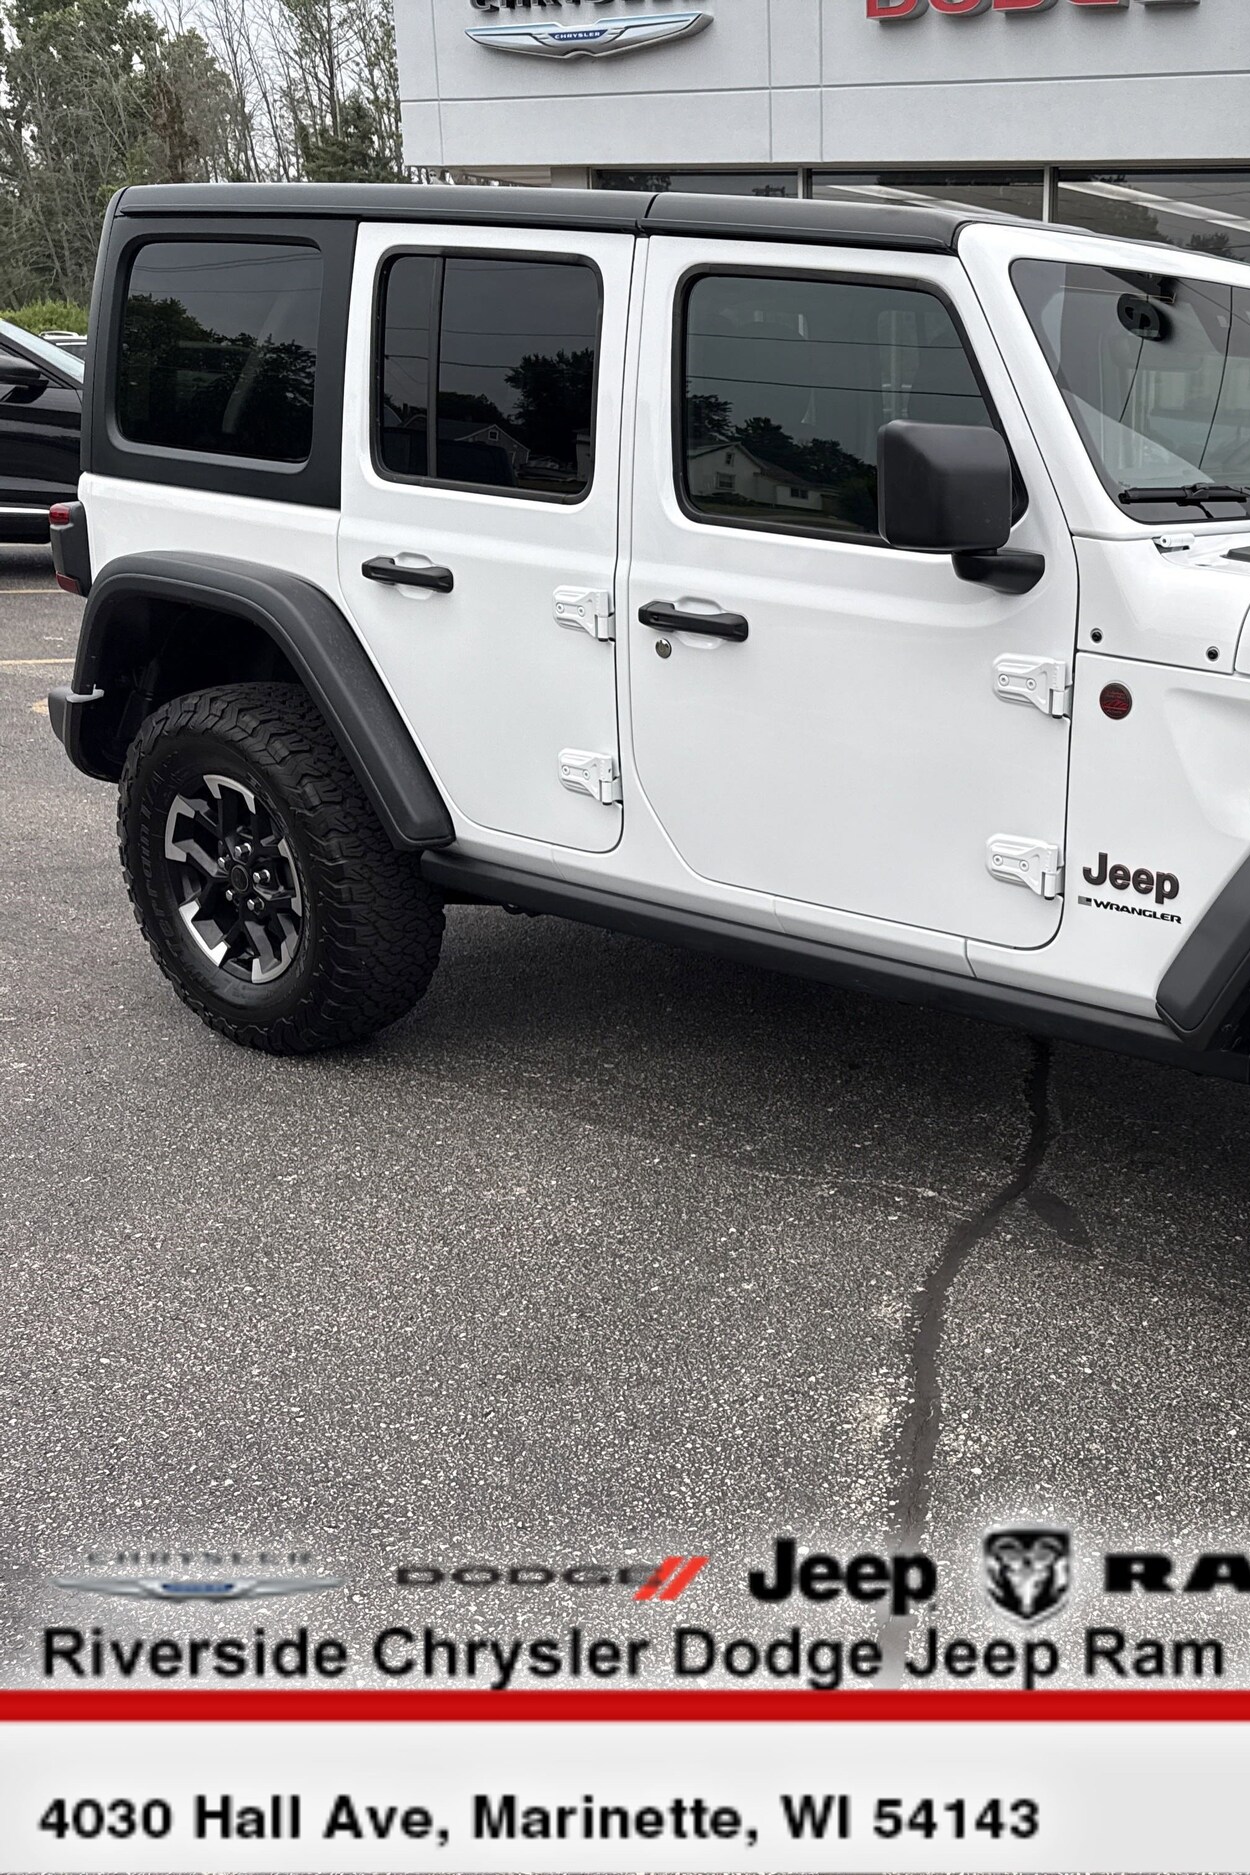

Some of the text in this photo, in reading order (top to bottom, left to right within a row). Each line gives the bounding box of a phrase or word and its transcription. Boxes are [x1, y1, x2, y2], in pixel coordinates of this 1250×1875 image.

[553, 31, 602, 40] CHRYSLER
[1082, 851, 1180, 905] Jeep
[1093, 898, 1182, 925] WRANGLER
